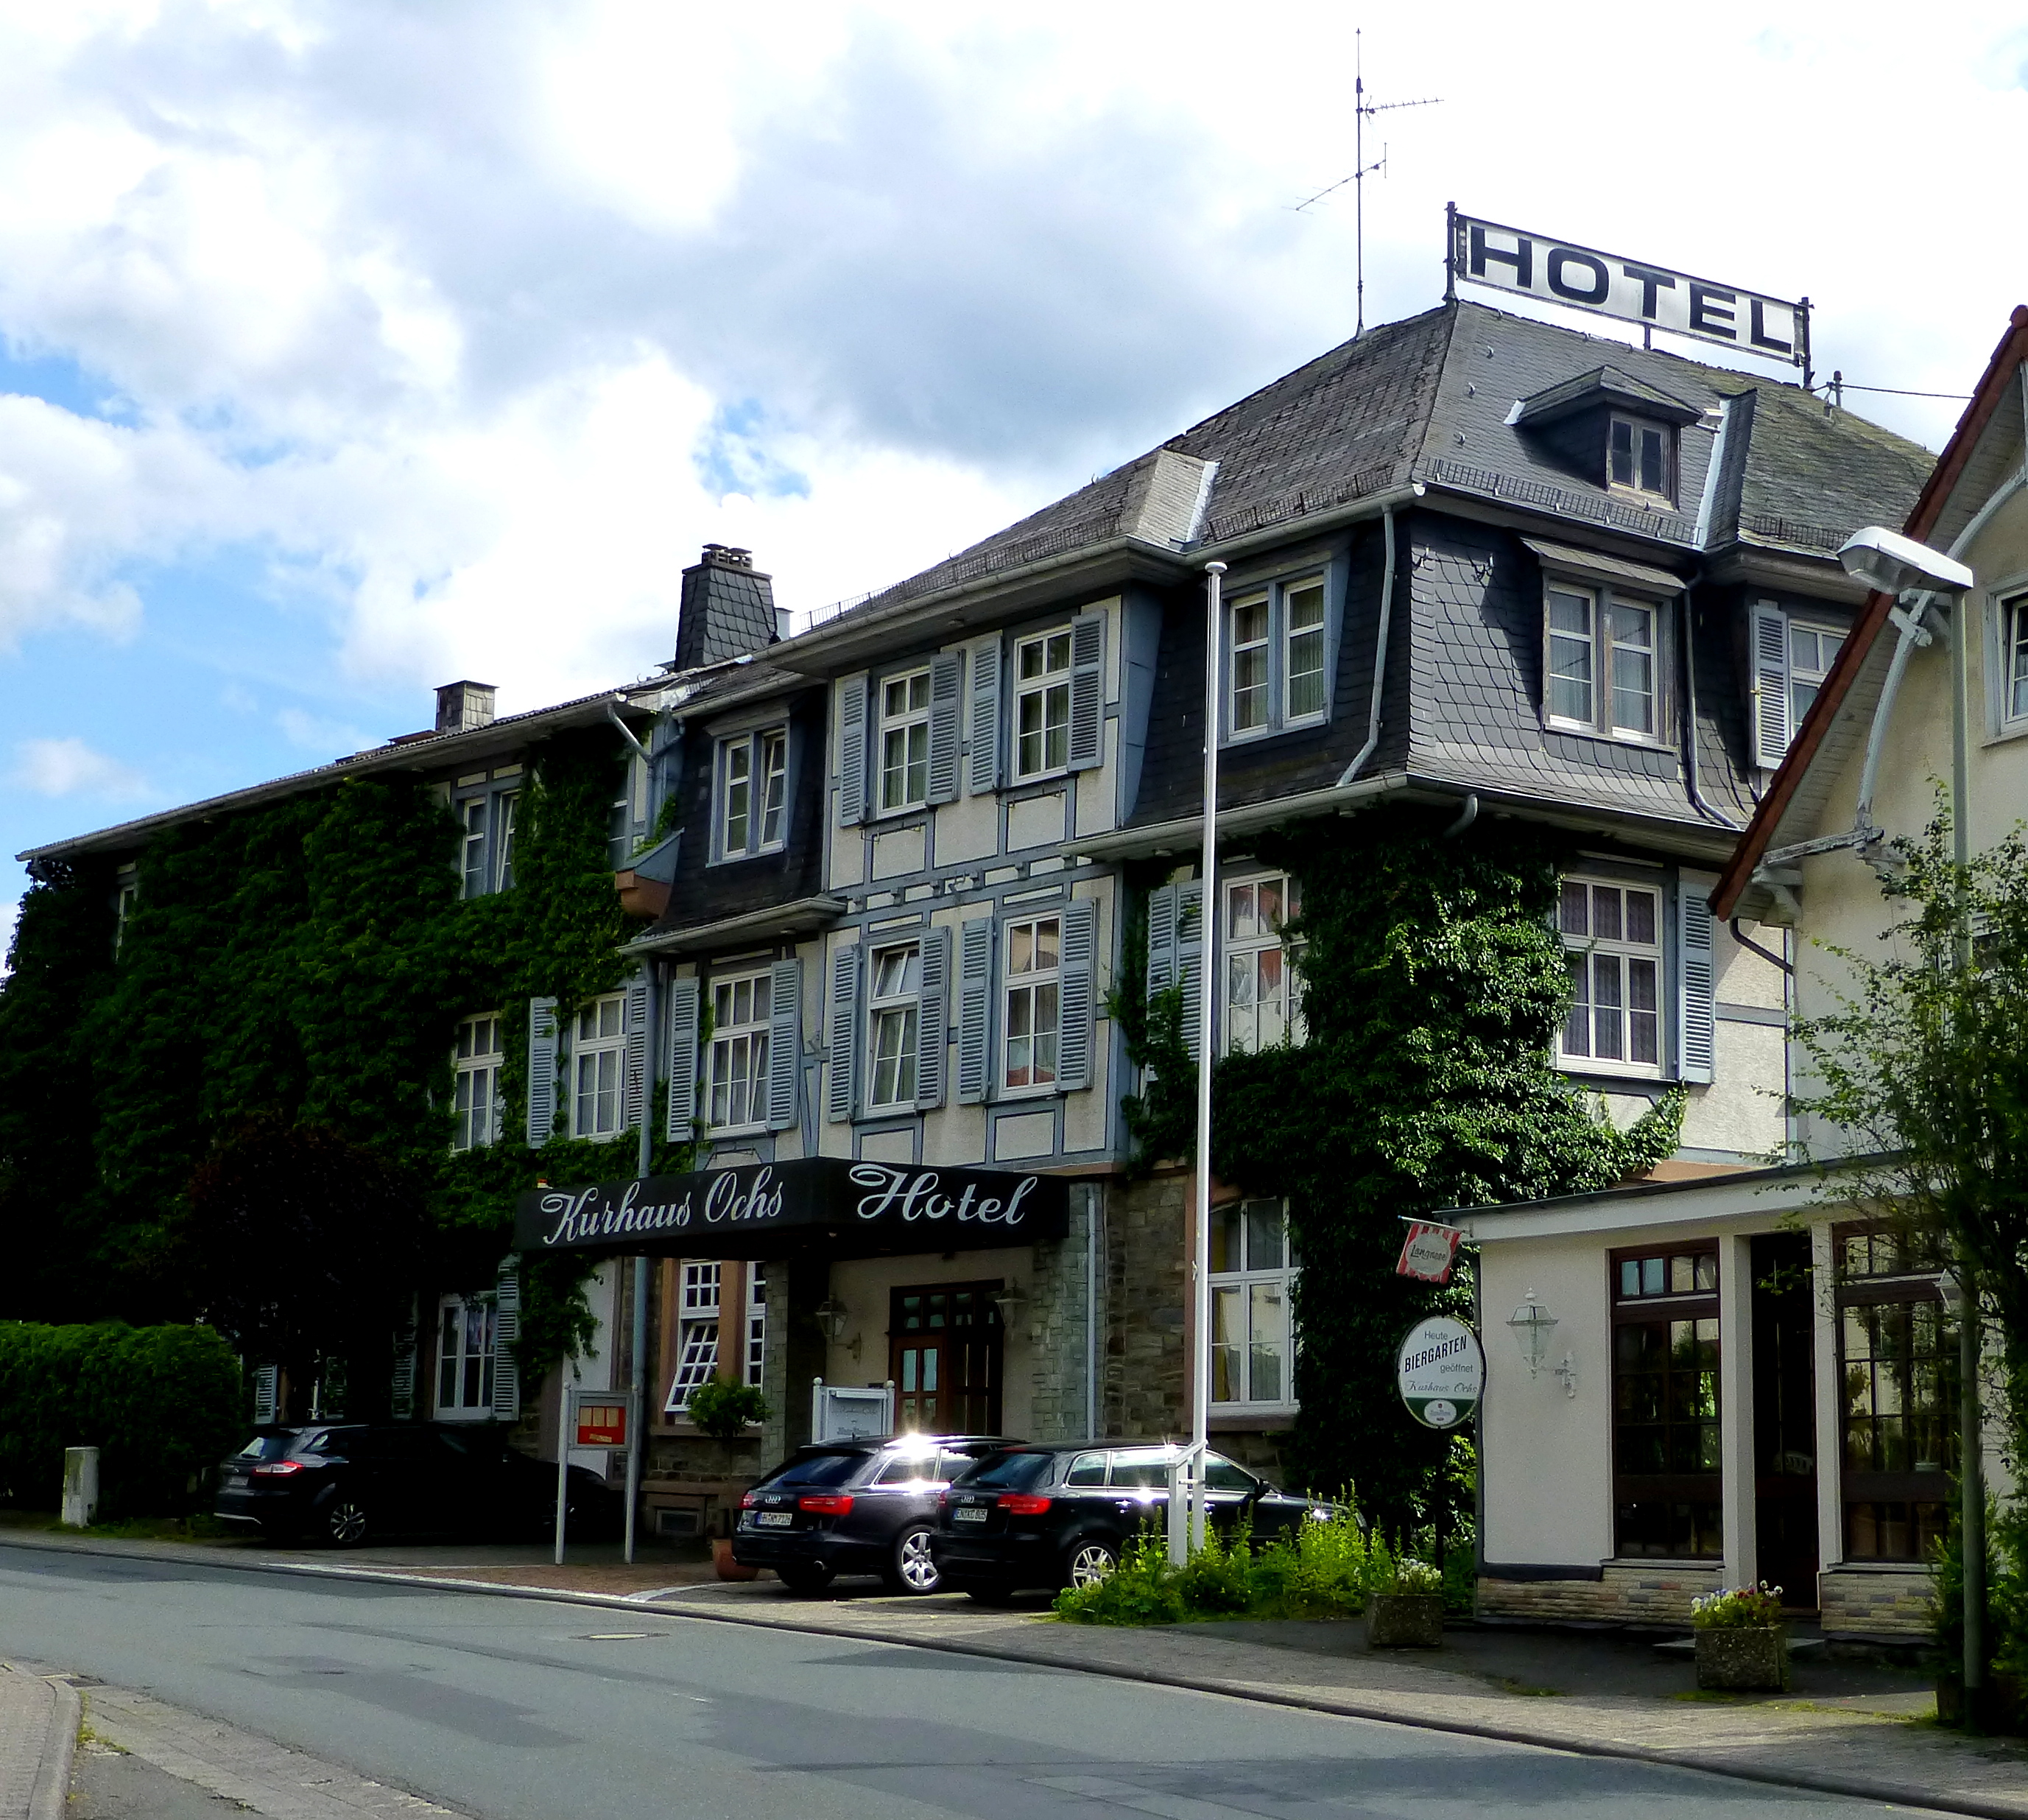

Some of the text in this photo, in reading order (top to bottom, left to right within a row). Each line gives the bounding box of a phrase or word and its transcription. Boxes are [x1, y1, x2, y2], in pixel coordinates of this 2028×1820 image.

[1470, 226, 1792, 354] HOTEL
[541, 1166, 783, 1245] Kurhaus Ochs
[850, 1163, 1038, 1226] Hotel
[1410, 1244, 1447, 1261] Langnese
[1404, 1335, 1467, 1373] BIERGARTEN
[1424, 1331, 1448, 1341] Heute
[1440, 1363, 1474, 1374] geöffnet
